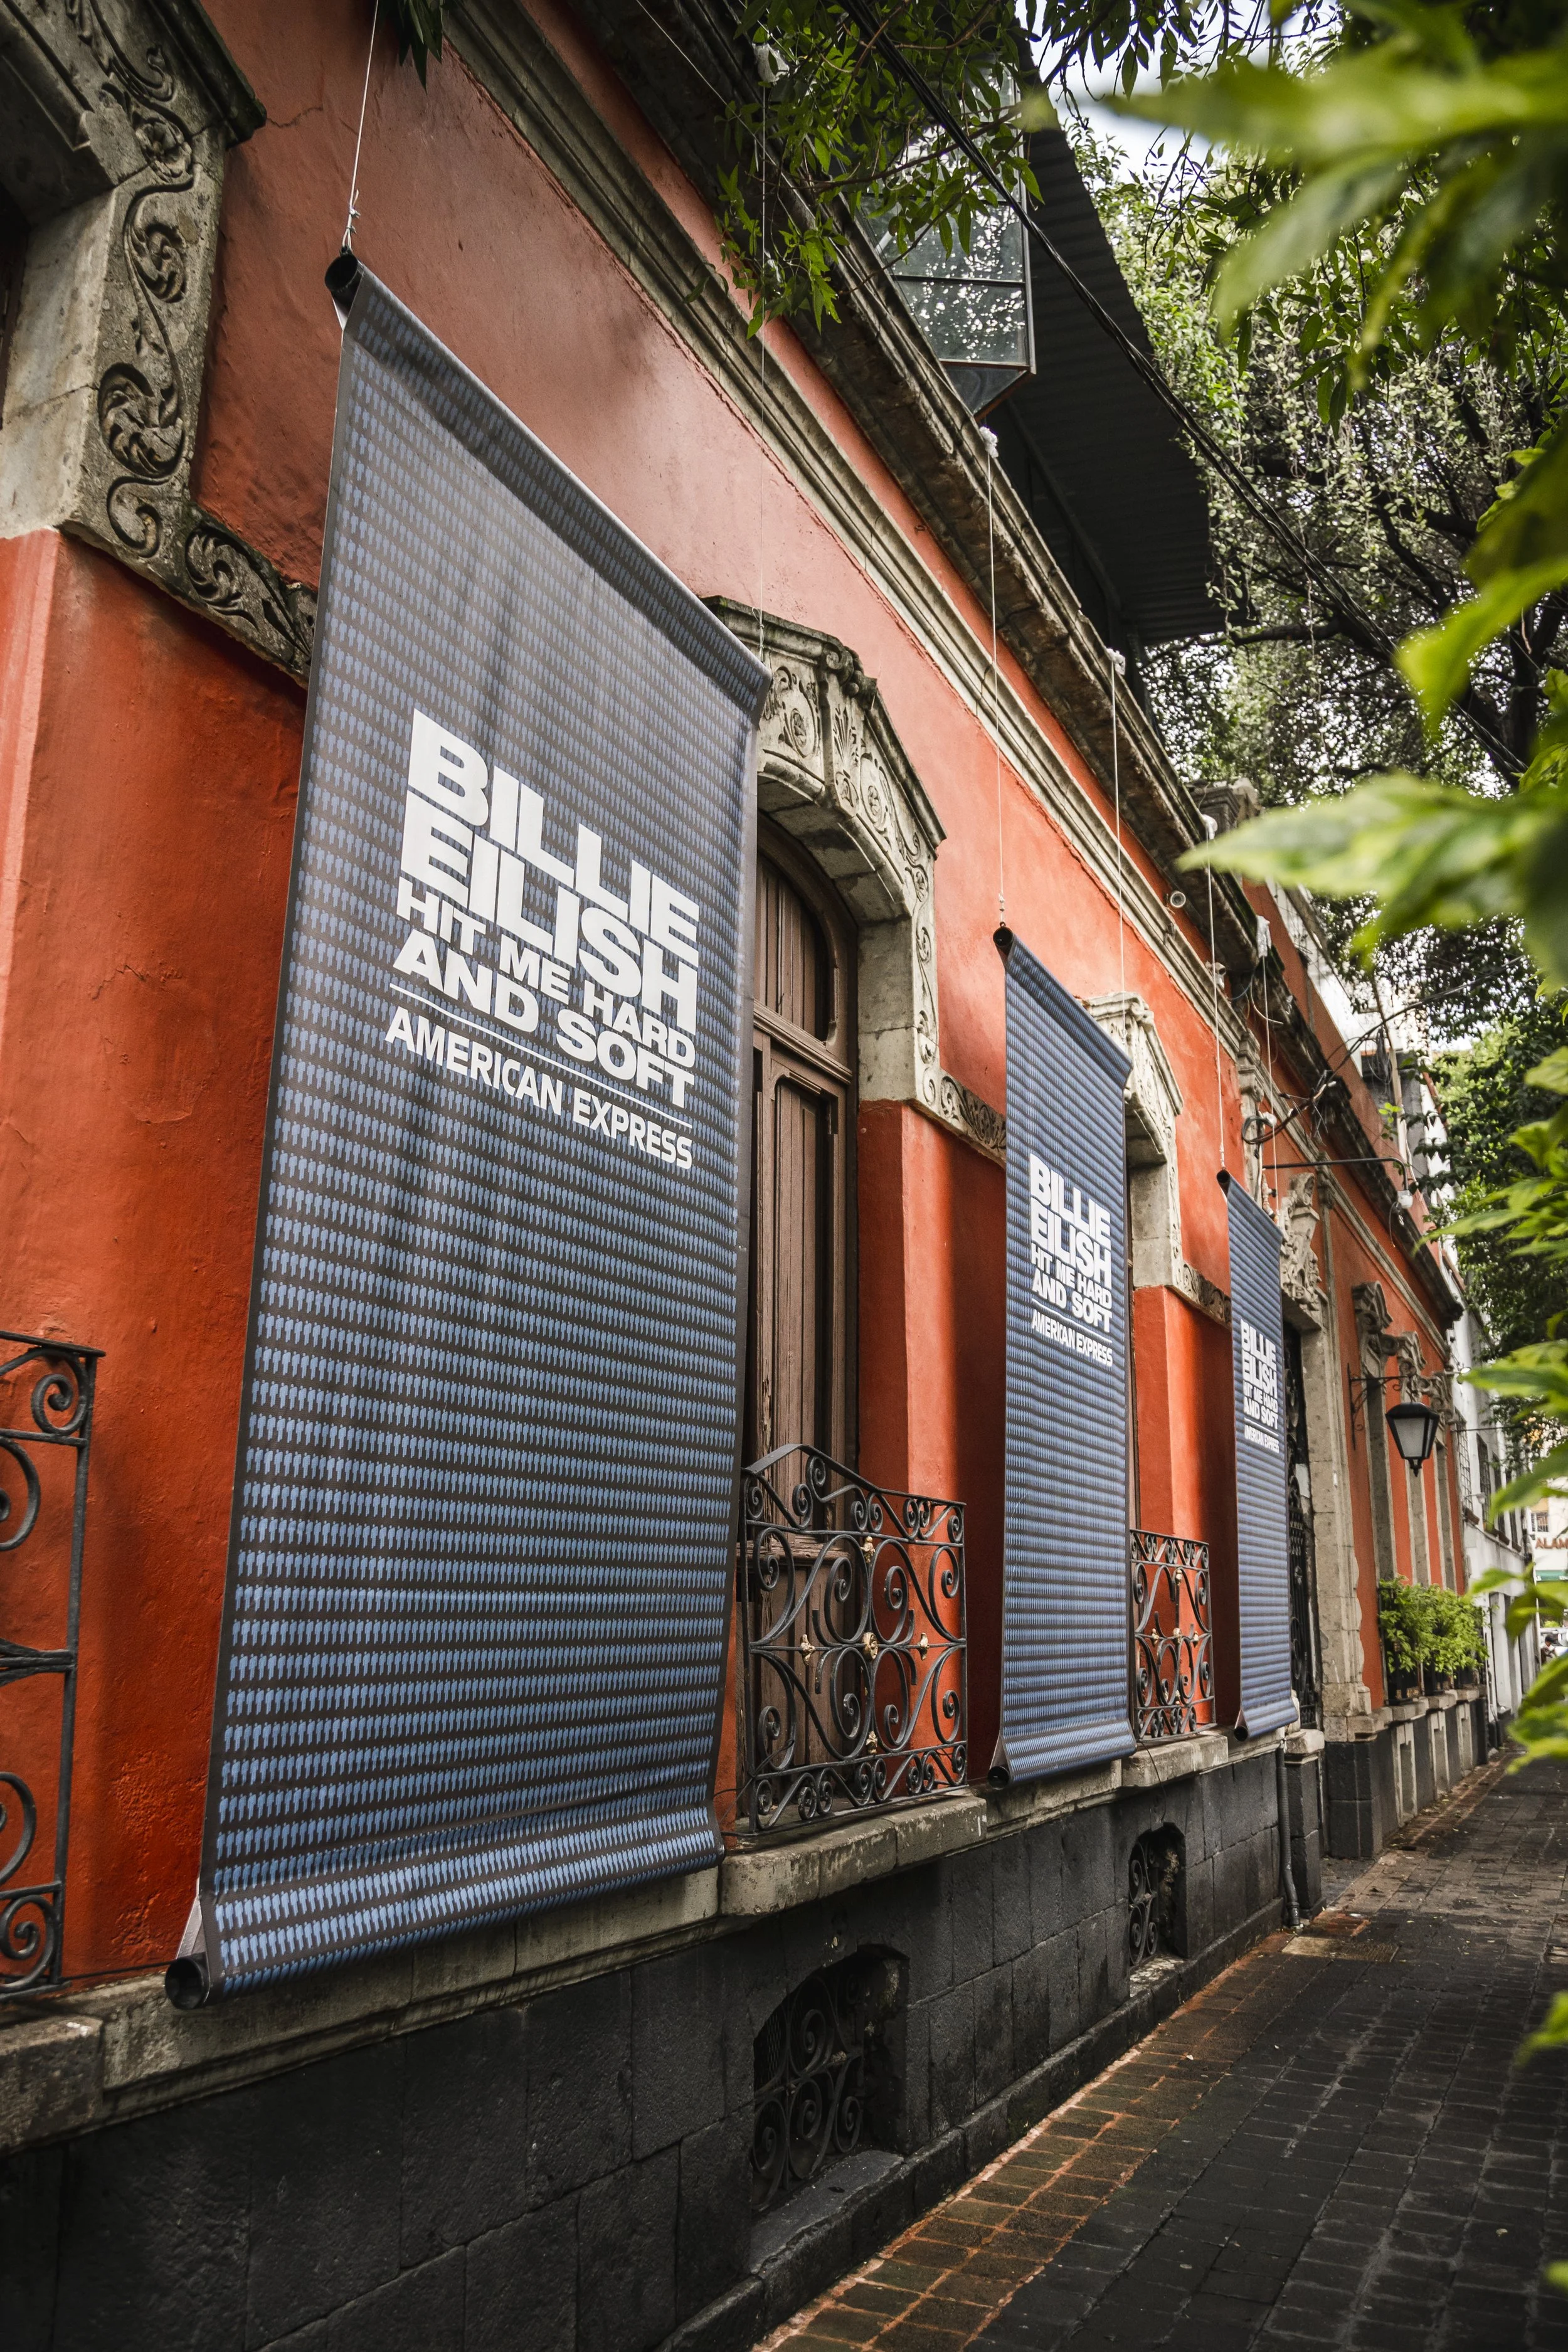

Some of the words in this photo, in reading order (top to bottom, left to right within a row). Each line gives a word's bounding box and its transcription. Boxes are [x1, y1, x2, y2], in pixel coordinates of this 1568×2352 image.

[408, 708, 699, 968] BILLIE
[400, 790, 697, 1036] EILISH
[396, 876, 487, 955] HIT
[499, 933, 570, 1005] ME
[583, 980, 696, 1067] HARD
[393, 929, 539, 1032] AND
[556, 1009, 695, 1108] SOFT
[384, 1006, 563, 1116] AMERICAN
[573, 1087, 692, 1170] EXPRESS
[1030, 1153, 1111, 1251] BILLIE
[1030, 1197, 1112, 1290] EILISH
[1031, 1242, 1053, 1274] HIT
[1056, 1259, 1075, 1289] ME
[1077, 1273, 1113, 1310] HARD
[1032, 1268, 1067, 1309] AND
[1071, 1291, 1113, 1333] SOFT
[1032, 1309, 1076, 1350] AMERICAN
[1076, 1332, 1113, 1367] EXPRESS
[1241, 1318, 1277, 1372] BILLIE
[1242, 1349, 1278, 1399] EILISH
[1243, 1380, 1253, 1398] HIT
[1254, 1386, 1263, 1405] ME
[1263, 1392, 1278, 1413] HARD
[1244, 1396, 1260, 1419] AND
[1261, 1405, 1279, 1430] SOFT
